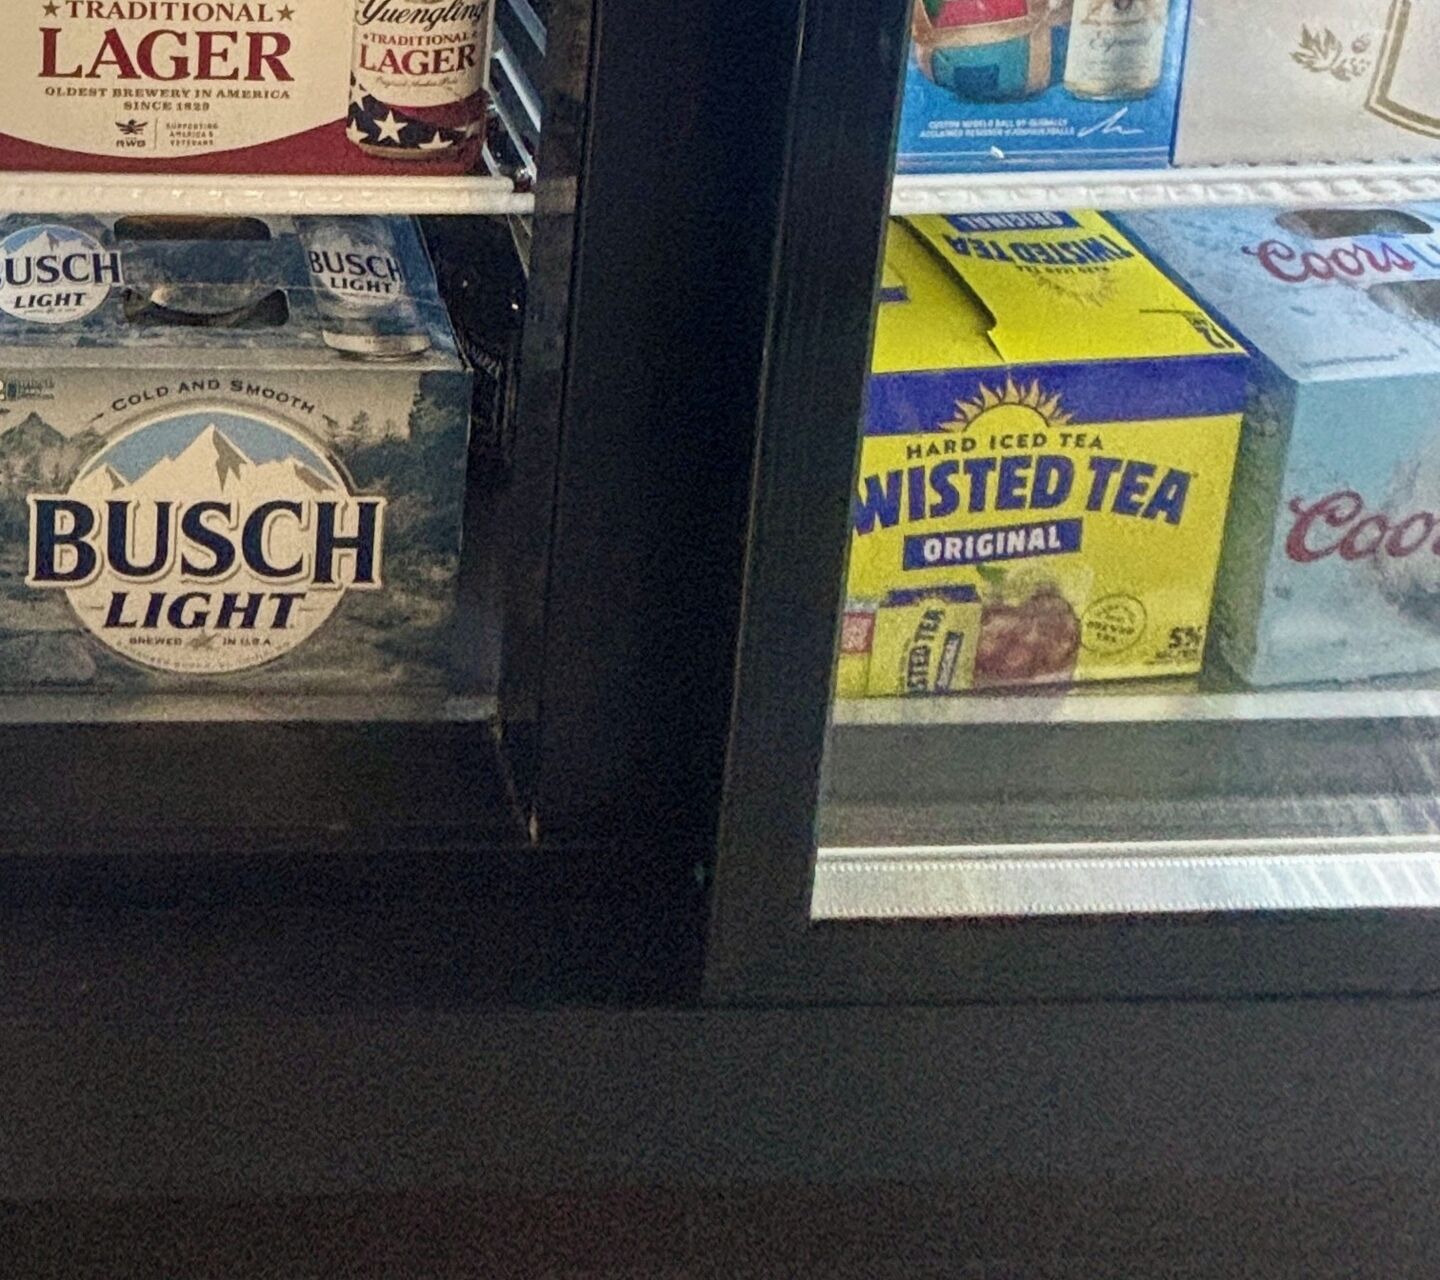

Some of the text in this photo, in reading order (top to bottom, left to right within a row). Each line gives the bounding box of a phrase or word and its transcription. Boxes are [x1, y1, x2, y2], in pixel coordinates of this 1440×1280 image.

[65, 0, 274, 22] TRADITIONAL
[38, 27, 295, 81] LAGER
[369, 31, 469, 46] TRADITIONAL
[360, 43, 477, 76] LAGER
[45, 86, 290, 100] OLDEST BREWERY IN AMERICA
[123, 101, 210, 111] SINCE 1829
[942, 233, 1133, 264] TWISTED TEA
[1241, 239, 1417, 283] Coors
[309, 249, 402, 281] BUSCH
[14, 291, 87, 310] LIGHT
[330, 275, 395, 295] LIGHT
[111, 378, 316, 414] COLD AND SMOOTH
[907, 433, 1103, 459] HARD ICED TEA
[855, 455, 1193, 536] WISTED TEA
[32, 497, 382, 585] BUSCH
[923, 521, 1061, 563] ORIGINAL
[103, 591, 307, 629] LIGHT
[129, 636, 238, 646] BREWED IN
